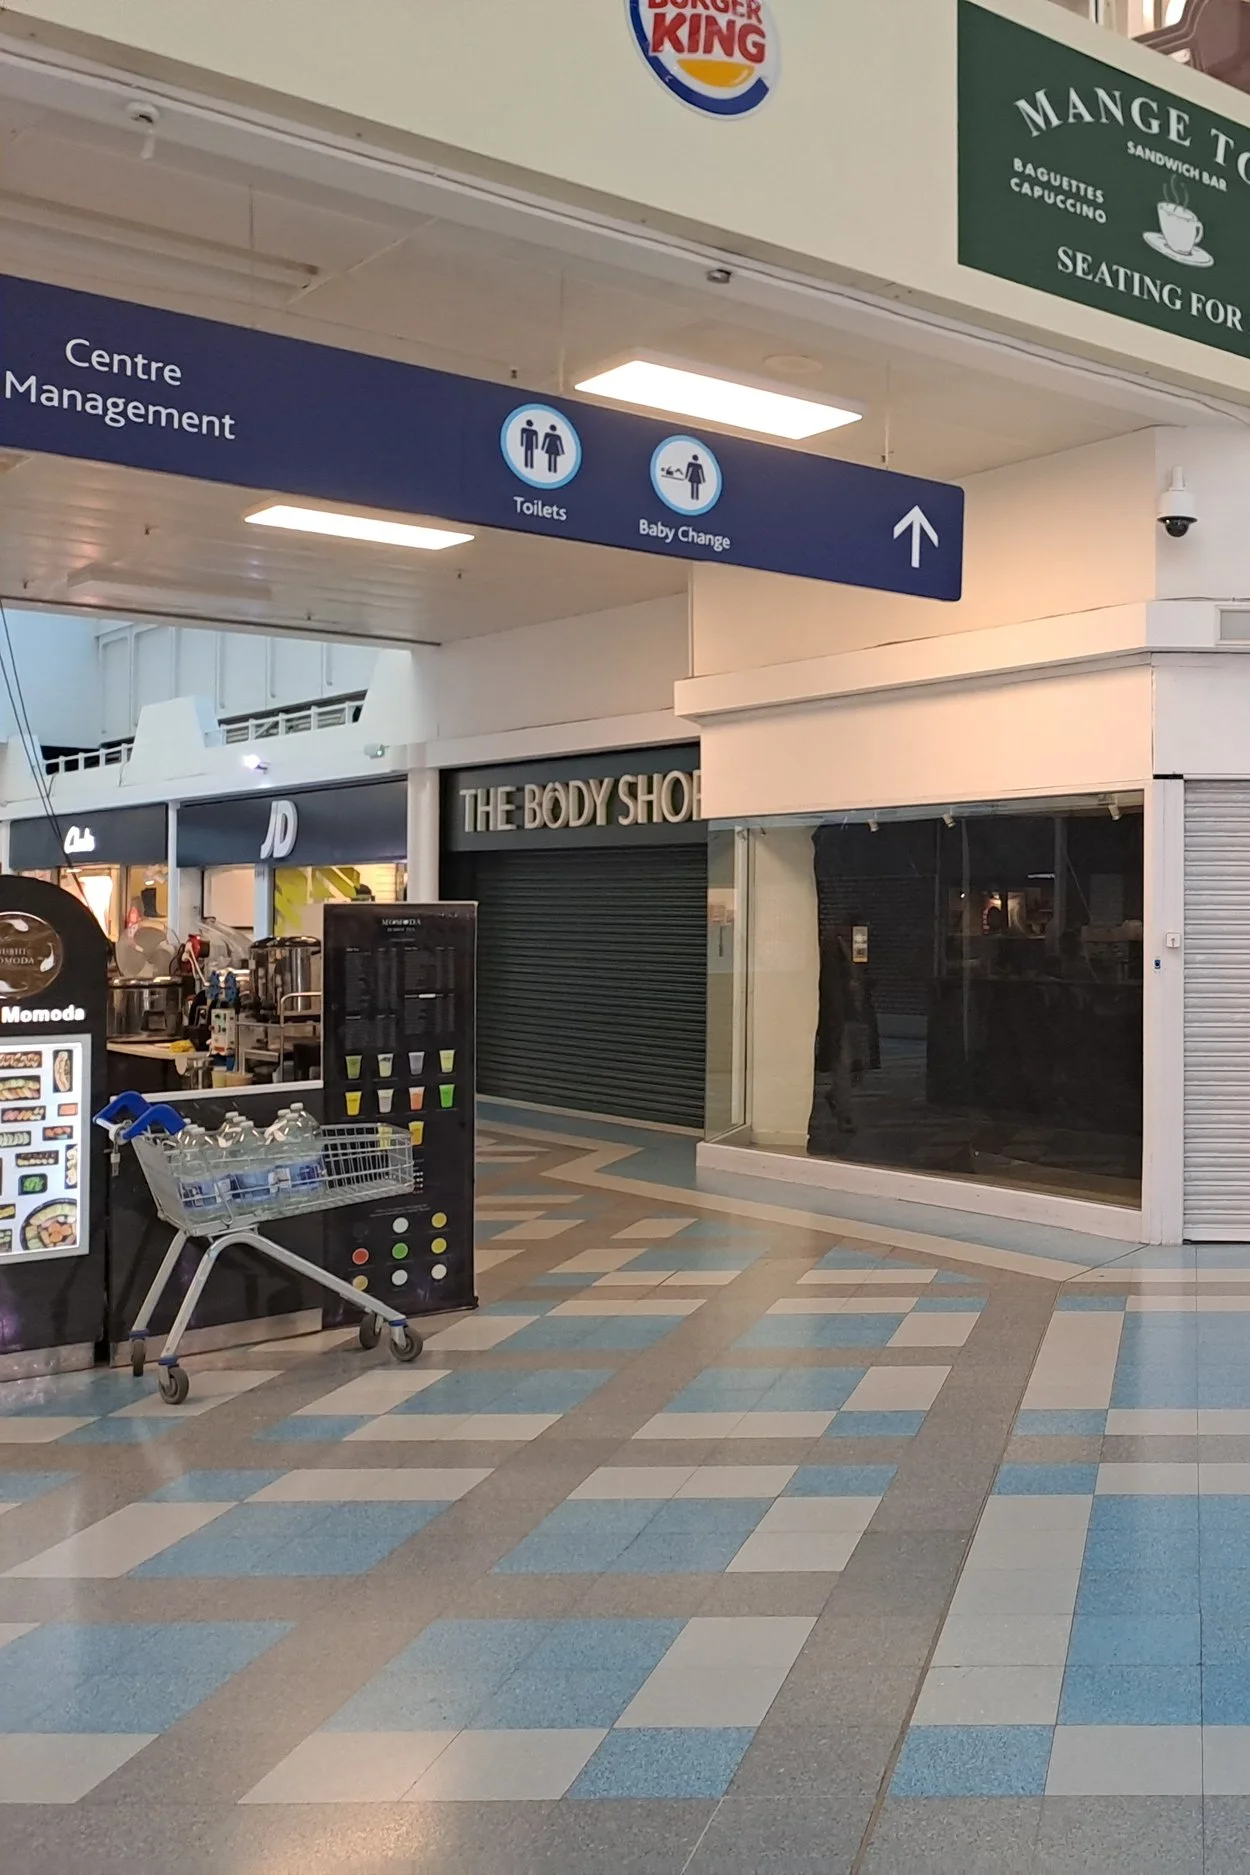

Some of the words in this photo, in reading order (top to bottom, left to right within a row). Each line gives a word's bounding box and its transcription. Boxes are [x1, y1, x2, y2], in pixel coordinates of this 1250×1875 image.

[651, 12, 766, 63] KING
[1013, 87, 1193, 147] MANGE
[1012, 157, 1105, 203] BAGUETTES
[1126, 140, 1200, 181] SANDWICH
[1201, 171, 1228, 192] BAR
[1009, 177, 1107, 224] CAPUCCINO
[1056, 246, 1183, 310] SEATING
[1189, 291, 1243, 332] FOR
[65, 338, 182, 386] Centre
[5, 370, 236, 440] Management
[513, 496, 568, 521] Toilets
[639, 518, 676, 543] Baby
[677, 526, 731, 551] Change
[459, 785, 518, 833] THE
[524, 776, 615, 829] BODY
[260, 800, 298, 859] JD
[0, 947, 26, 957] USHI
[1, 1004, 86, 1023] Momoda
